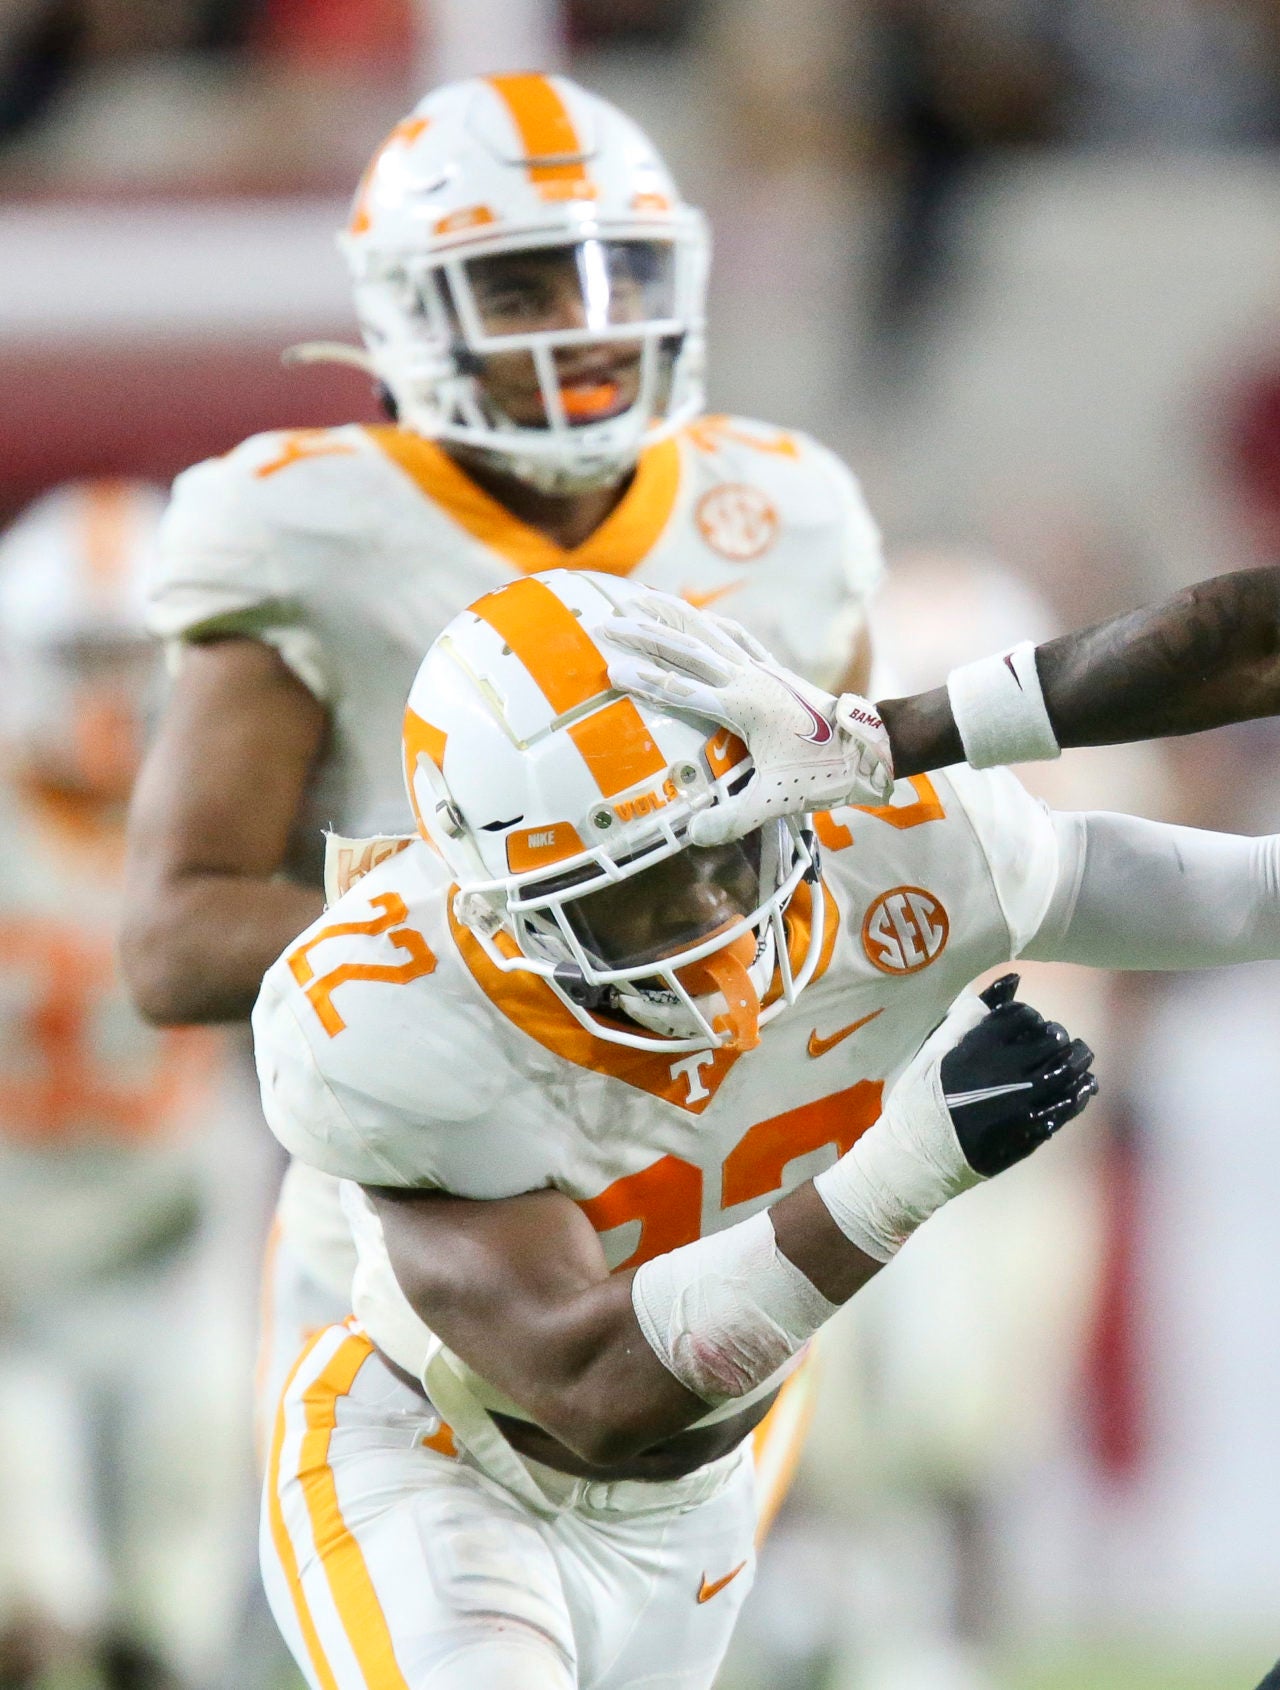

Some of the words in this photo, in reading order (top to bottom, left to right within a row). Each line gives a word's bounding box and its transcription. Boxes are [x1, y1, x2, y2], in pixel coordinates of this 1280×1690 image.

[848, 707, 884, 730] BAMA
[613, 777, 679, 823] VOLS
[527, 830, 555, 849] NIKE
[868, 891, 944, 970] SEC
[286, 891, 439, 1039] 22
[669, 1049, 715, 1105] T
